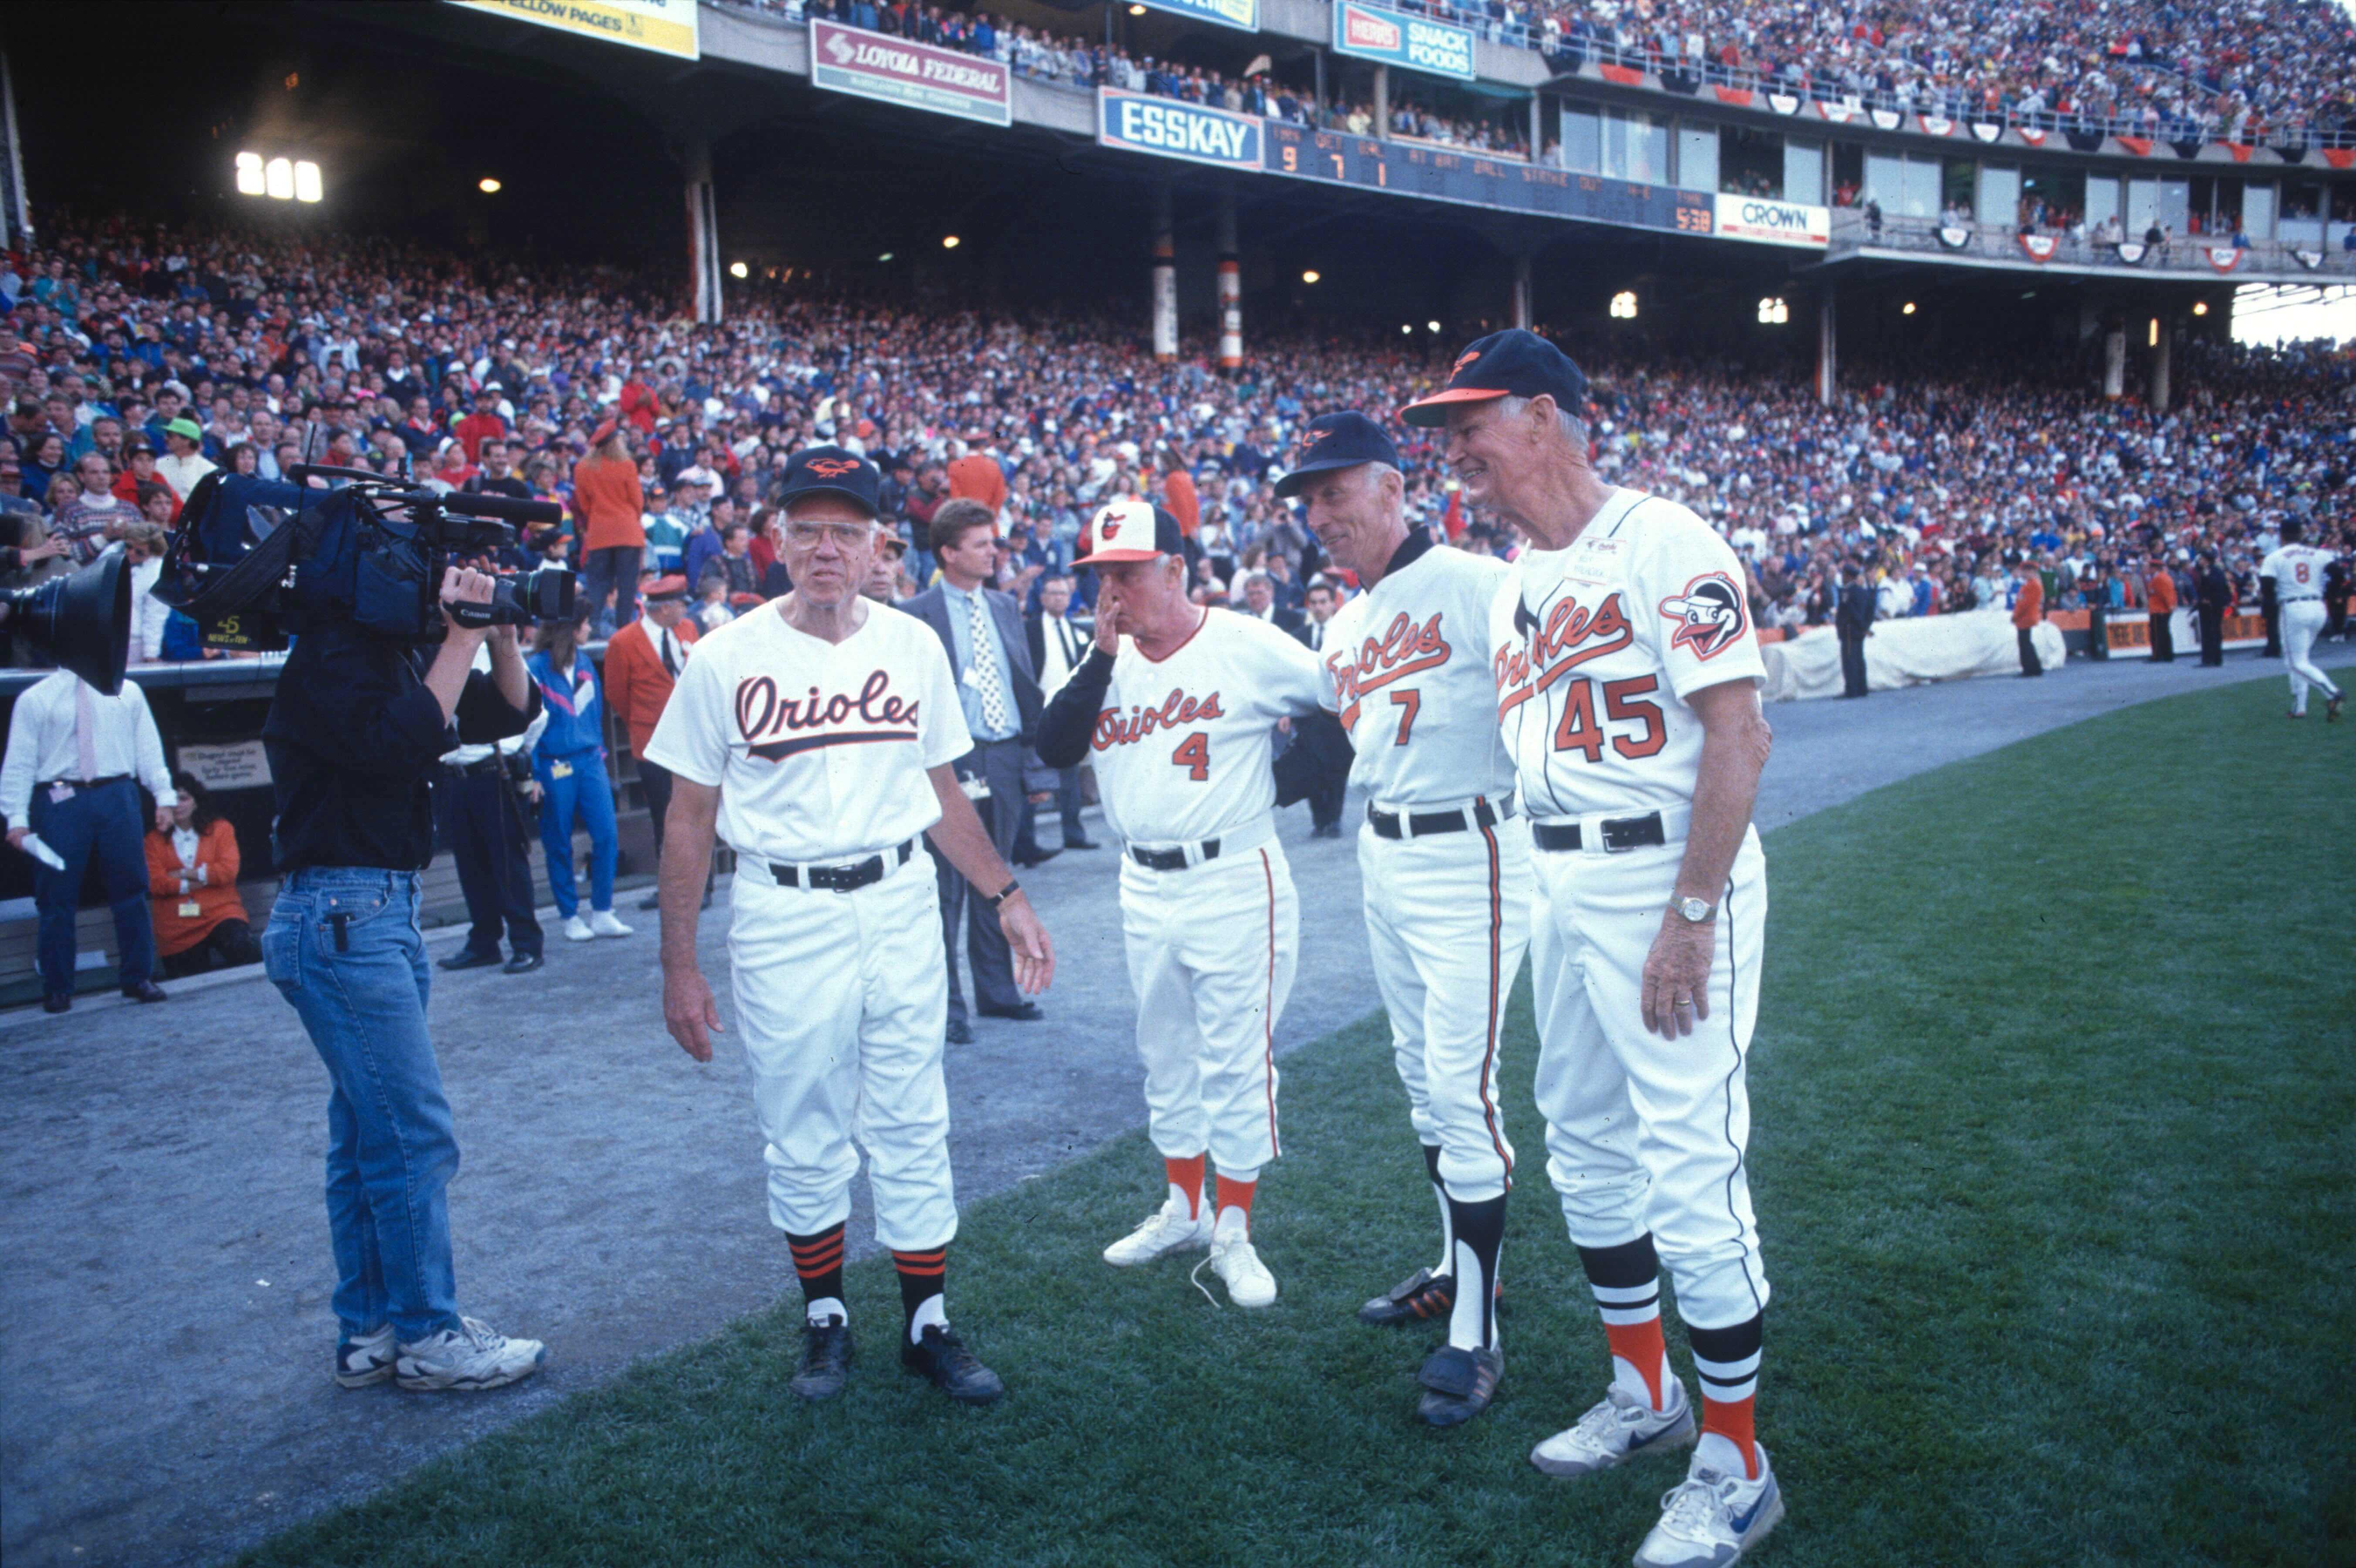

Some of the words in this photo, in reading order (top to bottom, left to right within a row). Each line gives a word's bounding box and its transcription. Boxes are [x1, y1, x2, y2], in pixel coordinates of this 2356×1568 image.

[570, 7, 622, 31] PAGES
[1408, 22, 1468, 53] SNACK
[855, 43, 920, 75] LOYOLA
[923, 58, 1001, 93] FEDERAL
[1408, 44, 1469, 72] FOODS
[1121, 101, 1248, 159] ESSKAY
[1282, 146, 1297, 172] 9
[1330, 154, 1344, 179] 7
[1378, 162, 1386, 187] 1
[1473, 160, 1506, 179] BALL
[1521, 167, 1568, 187] STRIKE
[1579, 176, 1602, 193] OUT
[1742, 202, 1808, 230] CROWN
[2295, 562, 2310, 584] 8
[460, 608, 491, 619] Canon
[208, 633, 230, 642] NEWS
[1090, 687, 1226, 752] Orioles
[1390, 689, 1420, 747] 7
[1554, 673, 1668, 763] 45
[1172, 731, 1209, 781] 4
